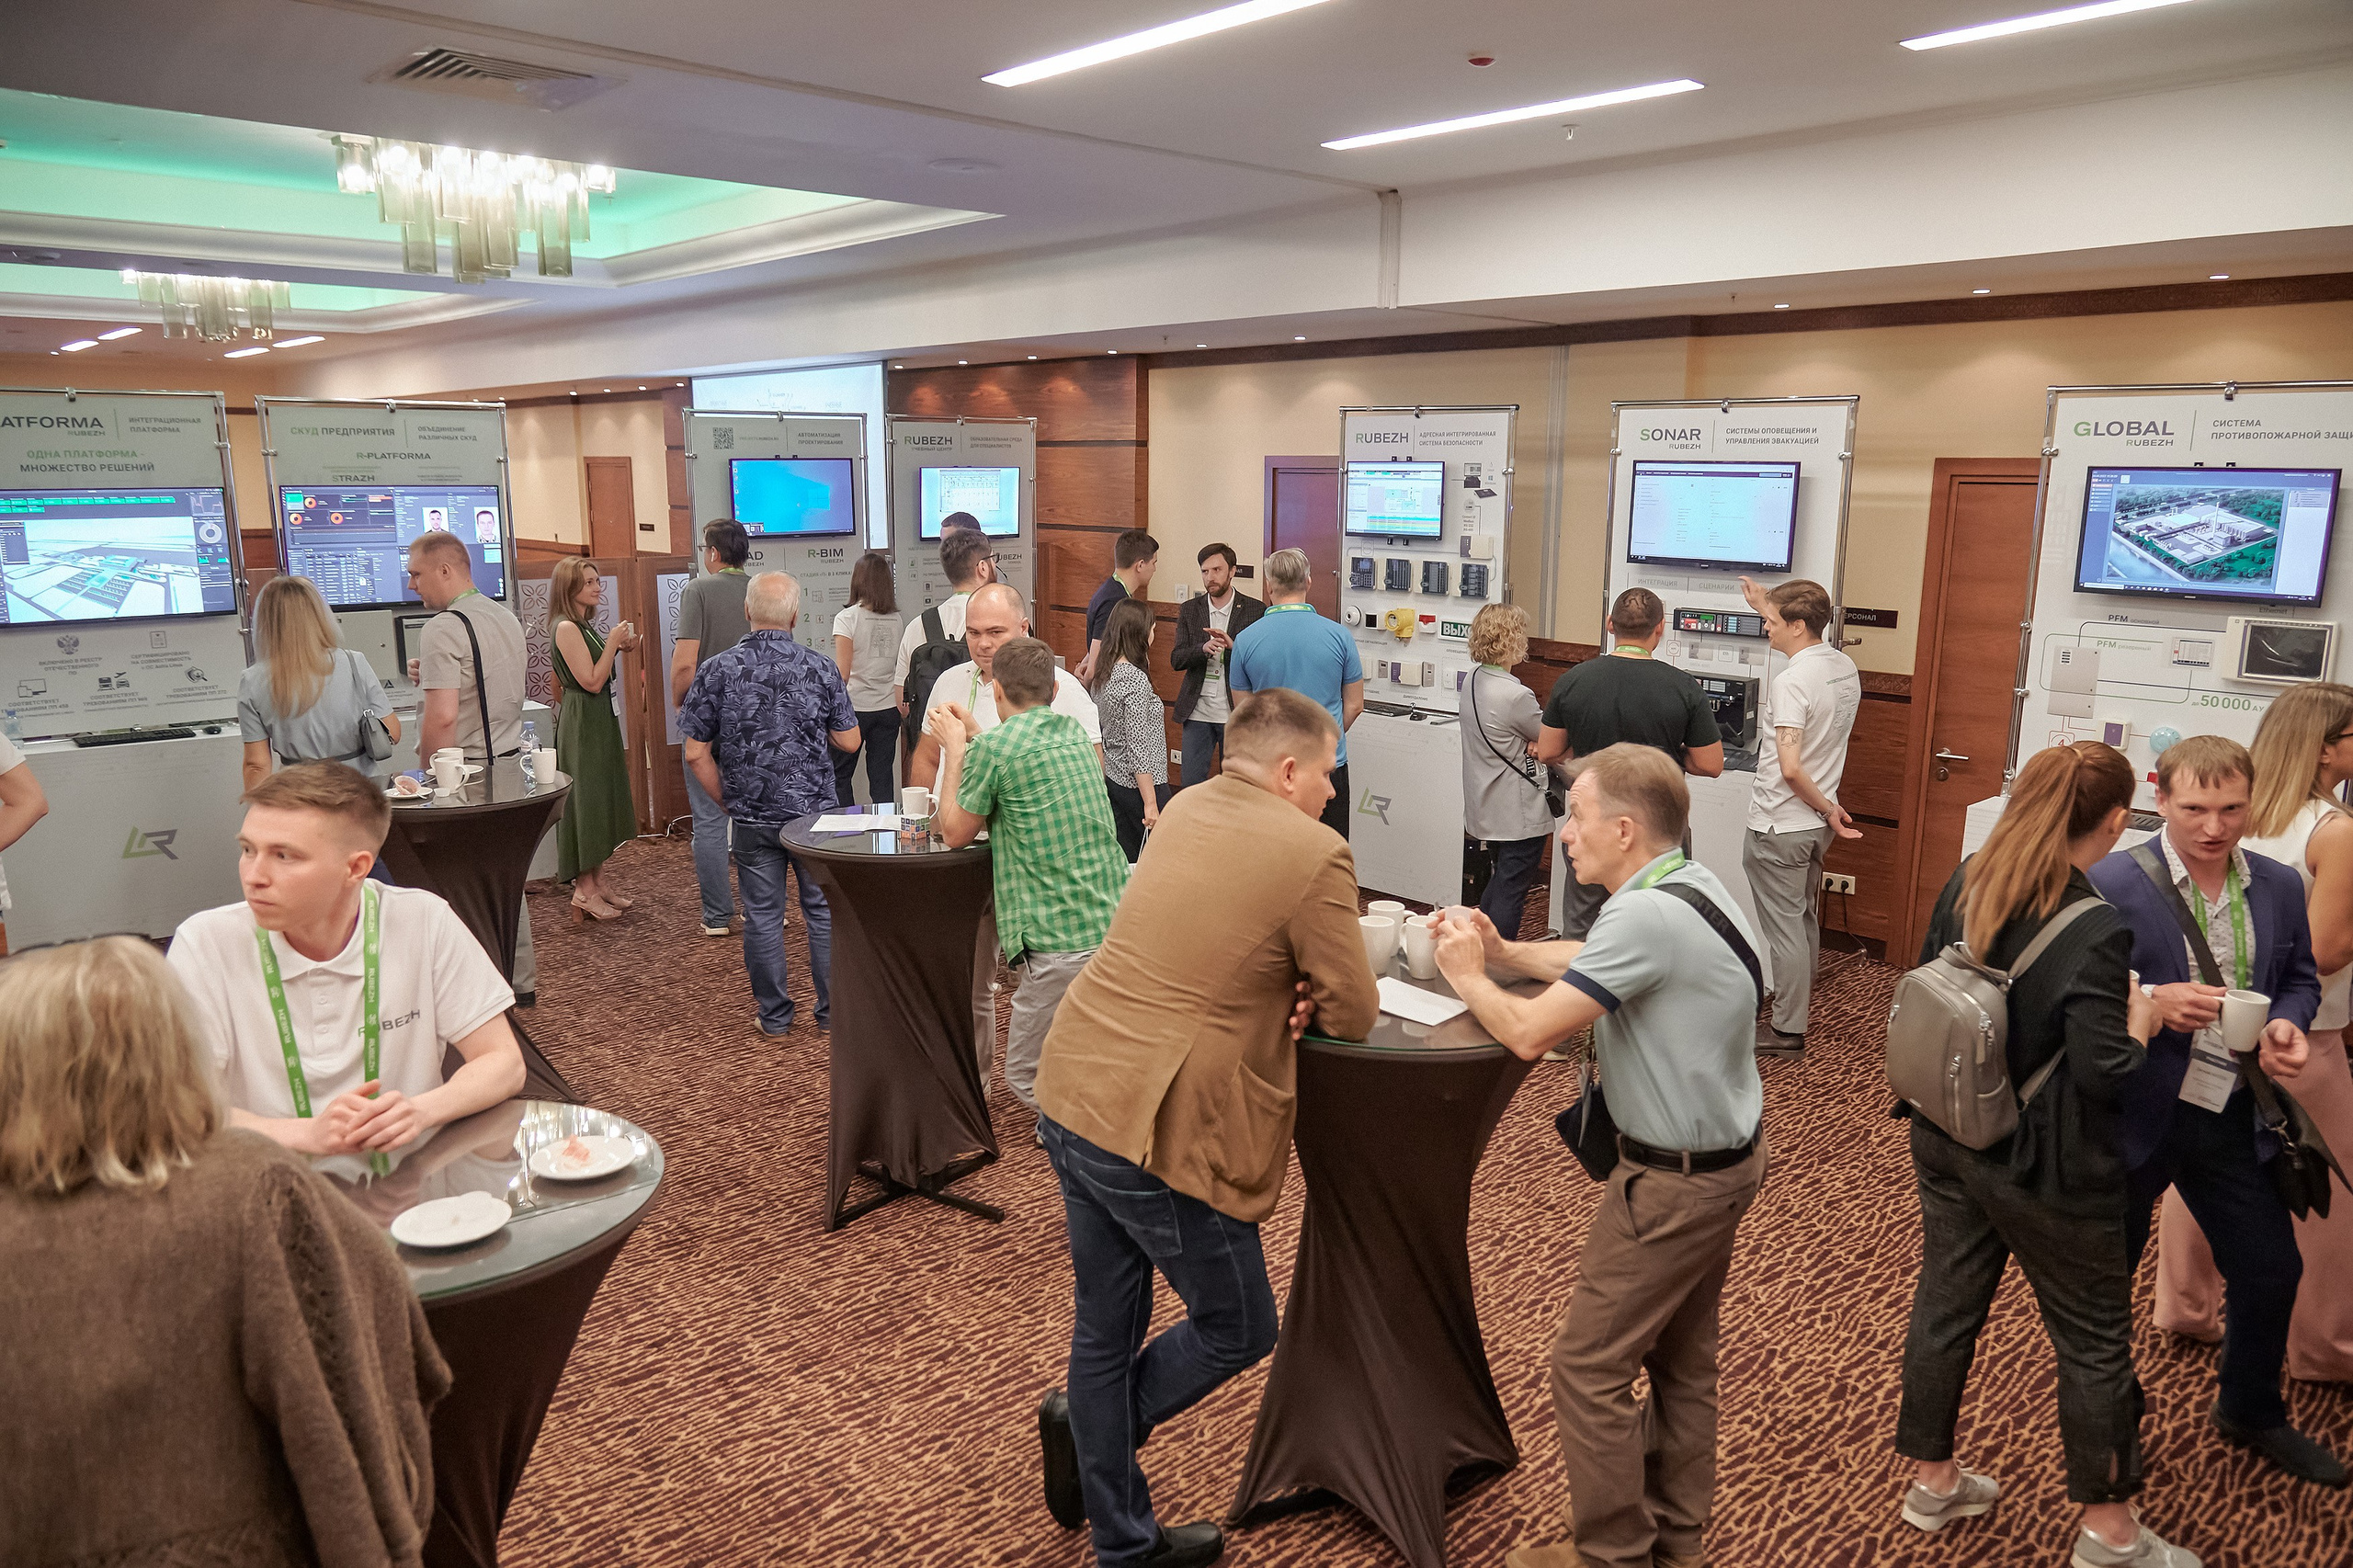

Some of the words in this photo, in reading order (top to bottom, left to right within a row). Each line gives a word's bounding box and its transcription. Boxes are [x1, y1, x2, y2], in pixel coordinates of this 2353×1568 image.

[129, 416, 201, 425] ИНТЕГРАЦИОННАЯ
[2212, 419, 2262, 427] СИСТЕМА
[290, 426, 319, 437] СКУД
[321, 427, 395, 437] ПРЕДПРИЯТИЯ
[2074, 421, 2175, 437] GLOBAL
[1356, 432, 1409, 444] RUBEZH
[1640, 428, 1701, 441] SONAR
[2211, 431, 2322, 440] ПРОТИВОПОЖАРНОЙ
[904, 436, 953, 445] RUBEZH
[1771, 437, 1819, 446] ЭВАКУАЦИЕЙ
[27, 450, 61, 460] ОДНА
[64, 449, 138, 459] ПЛАТФОРМА
[20, 463, 97, 472] МНОЖЕСТВО
[100, 461, 154, 472] РЕШЕНИЙ
[808, 548, 844, 558] R-BIM
[1637, 578, 1677, 587] ИНТЕГРАЦИЯ
[1699, 583, 1734, 591] СЦЕНАРИИ
[803, 587, 808, 597] 1
[803, 613, 810, 622] 2
[2108, 614, 2129, 622] PFM
[806, 638, 813, 647] 3
[2097, 640, 2117, 649] PFM
[278, 1008, 291, 1044] RUBEZH
[358, 1009, 421, 1037] RBEZH
